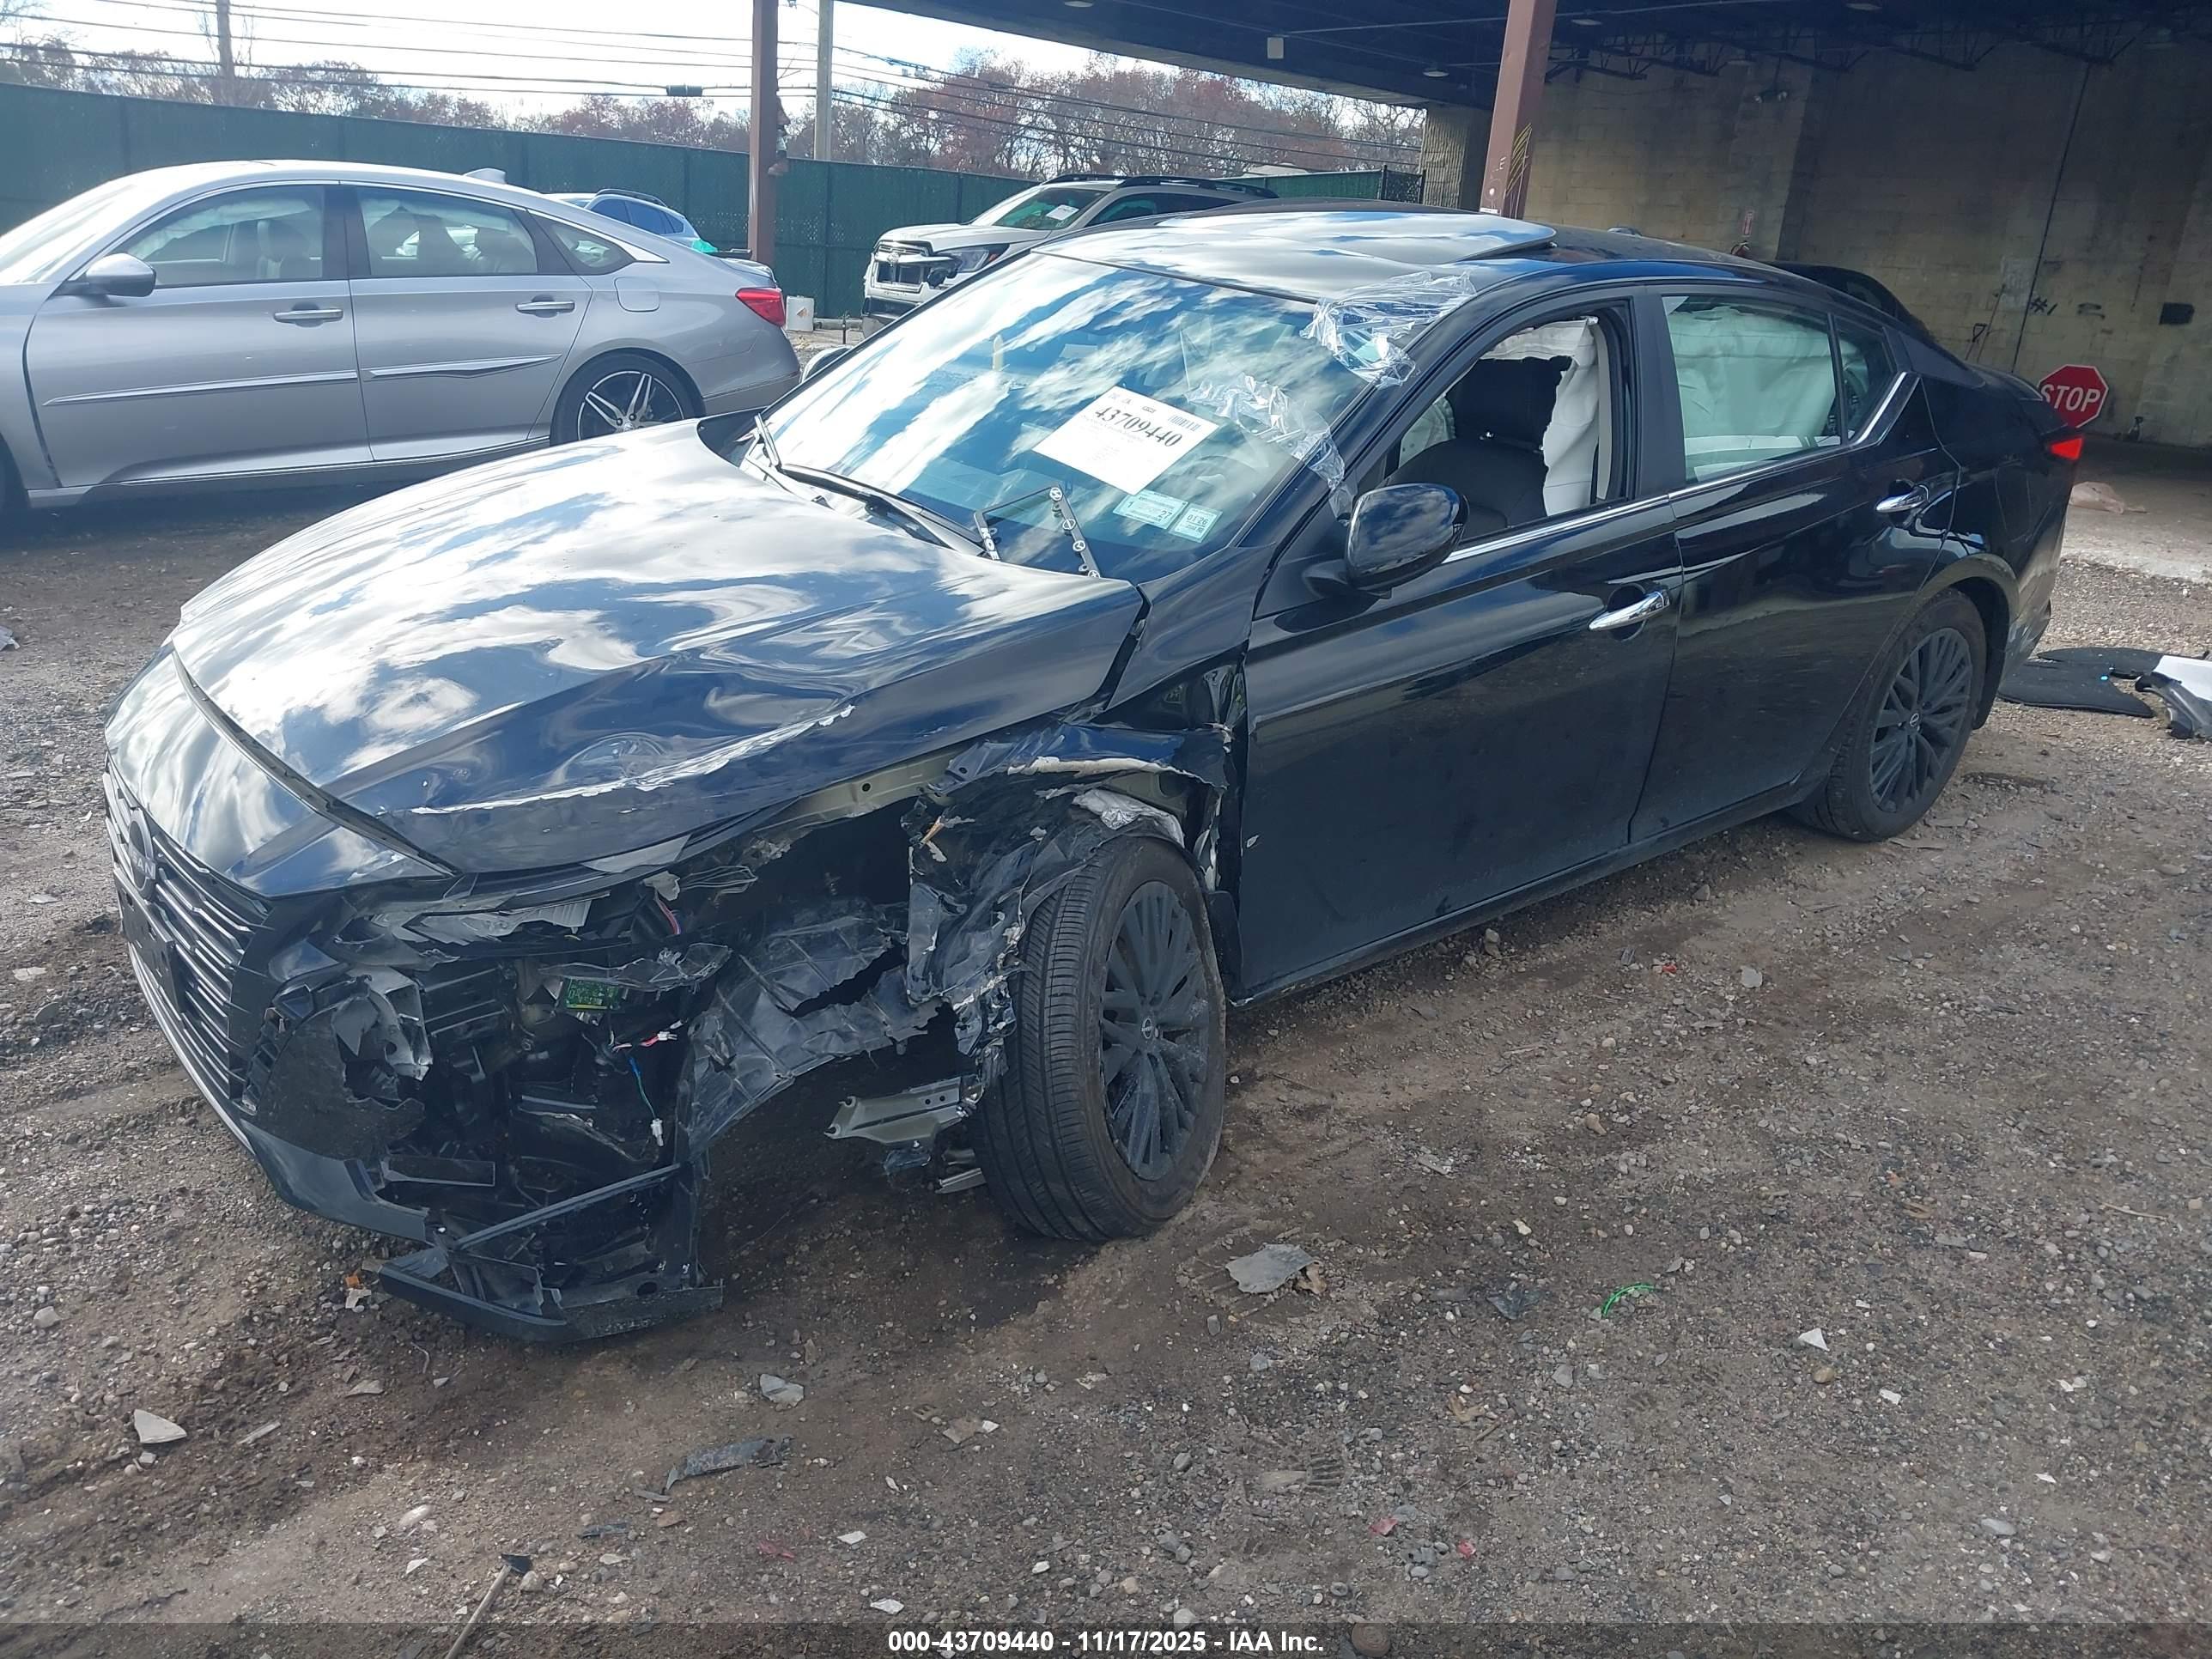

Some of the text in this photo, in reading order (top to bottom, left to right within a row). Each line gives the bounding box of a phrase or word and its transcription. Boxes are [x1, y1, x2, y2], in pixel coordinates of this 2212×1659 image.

[2040, 384, 2101, 412] STOP
[1095, 406, 1182, 447] 43709440
[1158, 510, 1173, 520] 27
